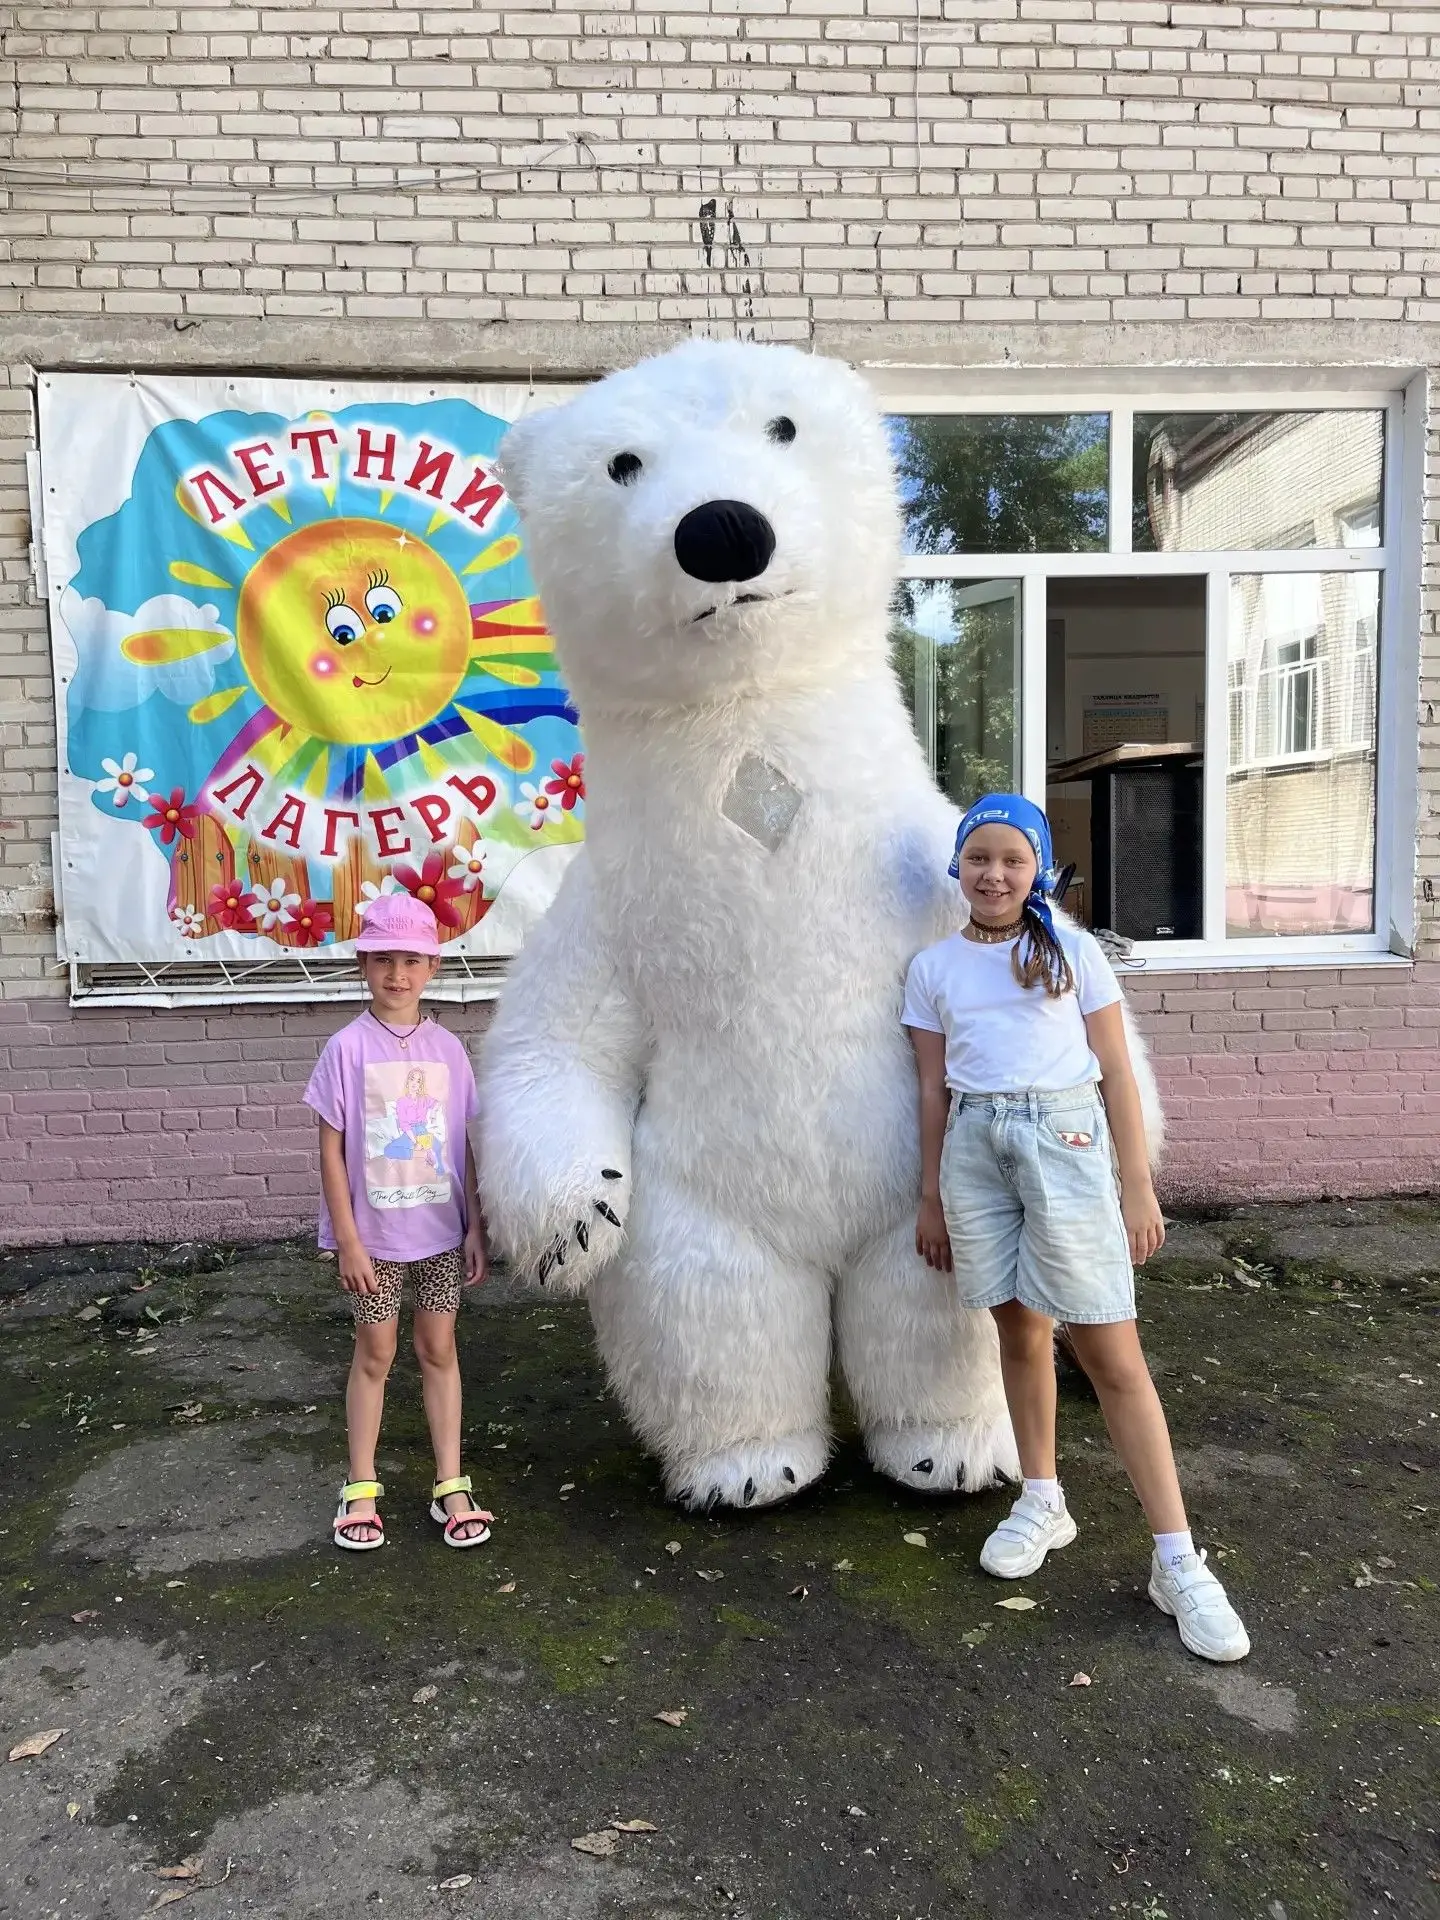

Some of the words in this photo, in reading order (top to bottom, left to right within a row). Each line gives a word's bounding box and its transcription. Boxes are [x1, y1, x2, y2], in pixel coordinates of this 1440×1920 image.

[213, 764, 498, 858] ЛАГЕРЬ
[370, 1189, 388, 1204] The
[416, 1185, 449, 1203] Day
